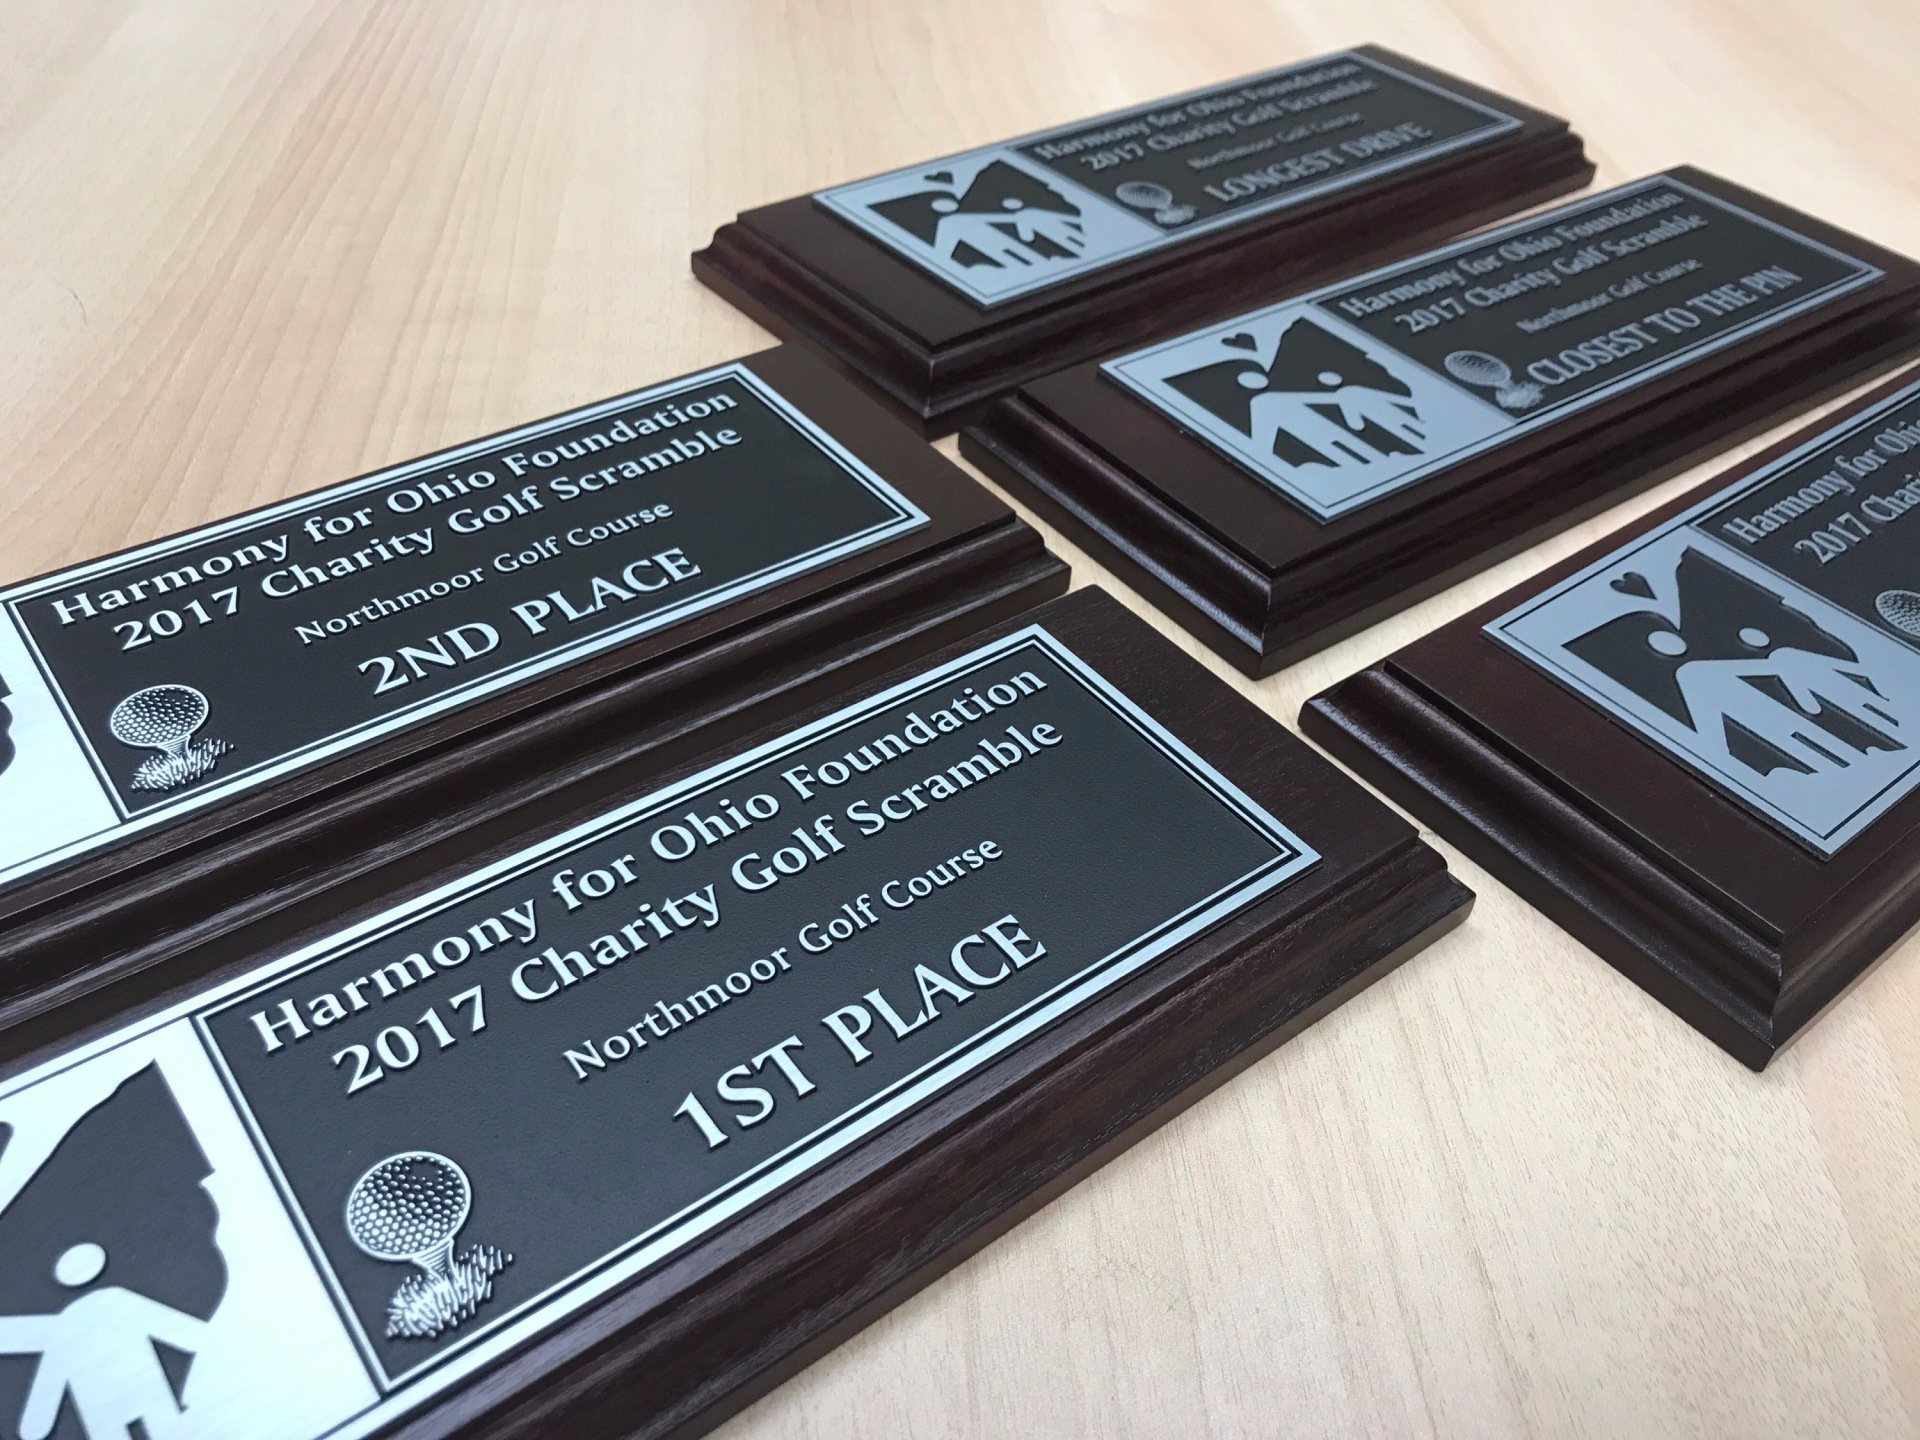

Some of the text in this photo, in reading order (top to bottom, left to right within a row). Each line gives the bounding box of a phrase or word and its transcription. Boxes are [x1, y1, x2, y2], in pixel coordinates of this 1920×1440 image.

[1080, 142, 1144, 171] 2017
[1204, 122, 1433, 202] LONGEST DRIVE
[1339, 192, 1684, 318] Harmony for Ohio Foundation
[1394, 213, 1709, 333] 2017 Charity Golf Scramble
[1527, 264, 1803, 385] CLOSEST TO THE PIN
[51, 391, 739, 628] Harmony for Ohio Foundation
[112, 423, 744, 652] 2017 Charity Golf Scramble
[1723, 420, 1920, 544] Harmony for Ohi
[1795, 472, 1920, 564] 2017 Char
[294, 499, 674, 647] Northmoor Golf Course
[357, 547, 703, 697] 2ND PLACE
[250, 666, 1048, 1054] Harmony for Ohio Foundation
[332, 716, 1064, 1096] 2017 Charity Golf Scramble
[563, 836, 1004, 1082] Northmoor Golf Course
[674, 914, 1048, 1150] 1ST PLACE
